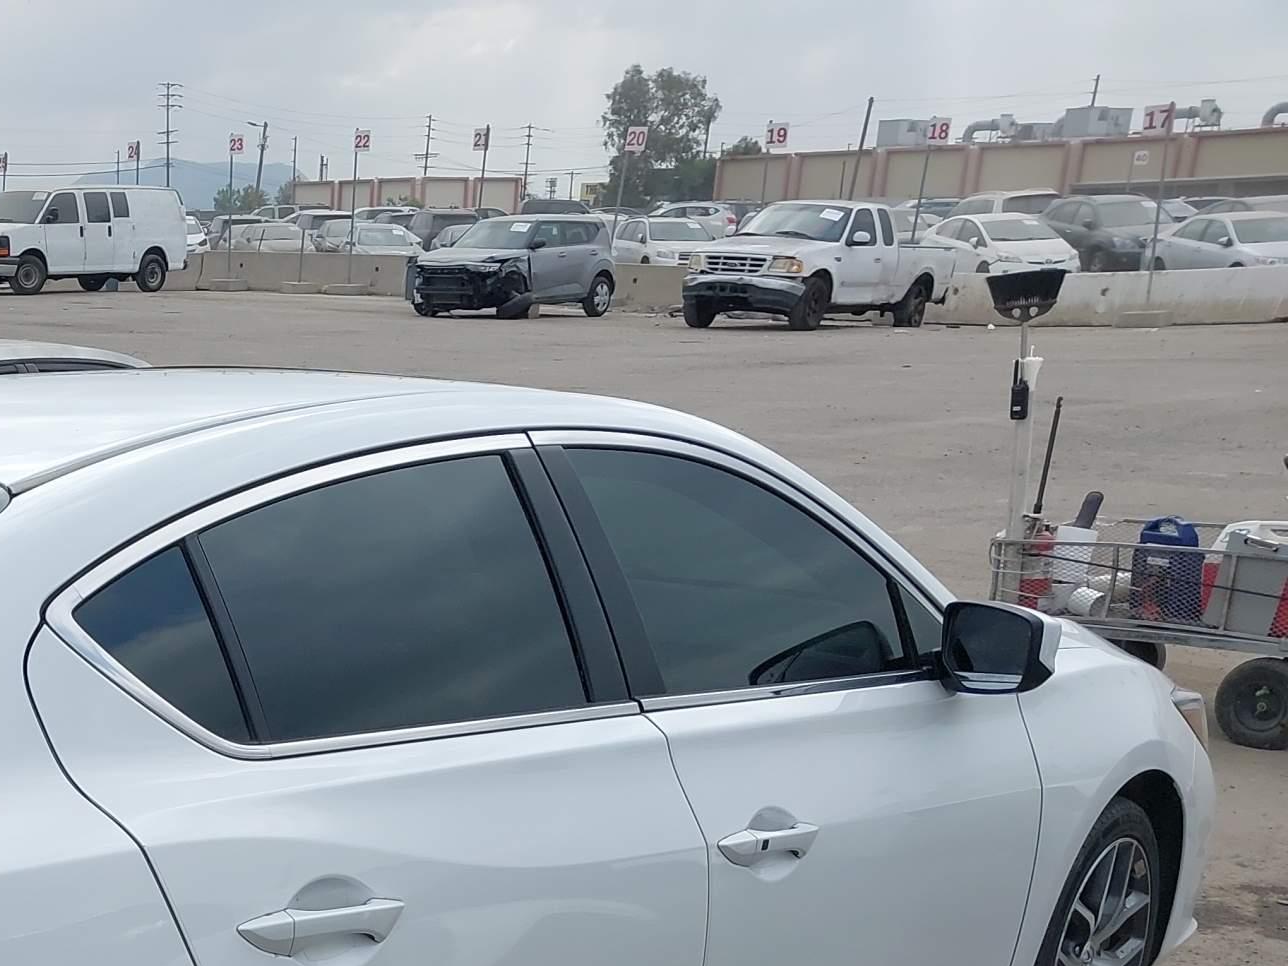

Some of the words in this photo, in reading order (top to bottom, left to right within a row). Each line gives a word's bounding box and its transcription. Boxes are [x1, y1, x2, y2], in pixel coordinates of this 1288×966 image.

[1143, 109, 1172, 130] 17
[626, 131, 646, 147] 20
[766, 127, 788, 145] 19
[927, 122, 949, 140] 18
[230, 137, 244, 151] 23
[354, 134, 370, 149] 22
